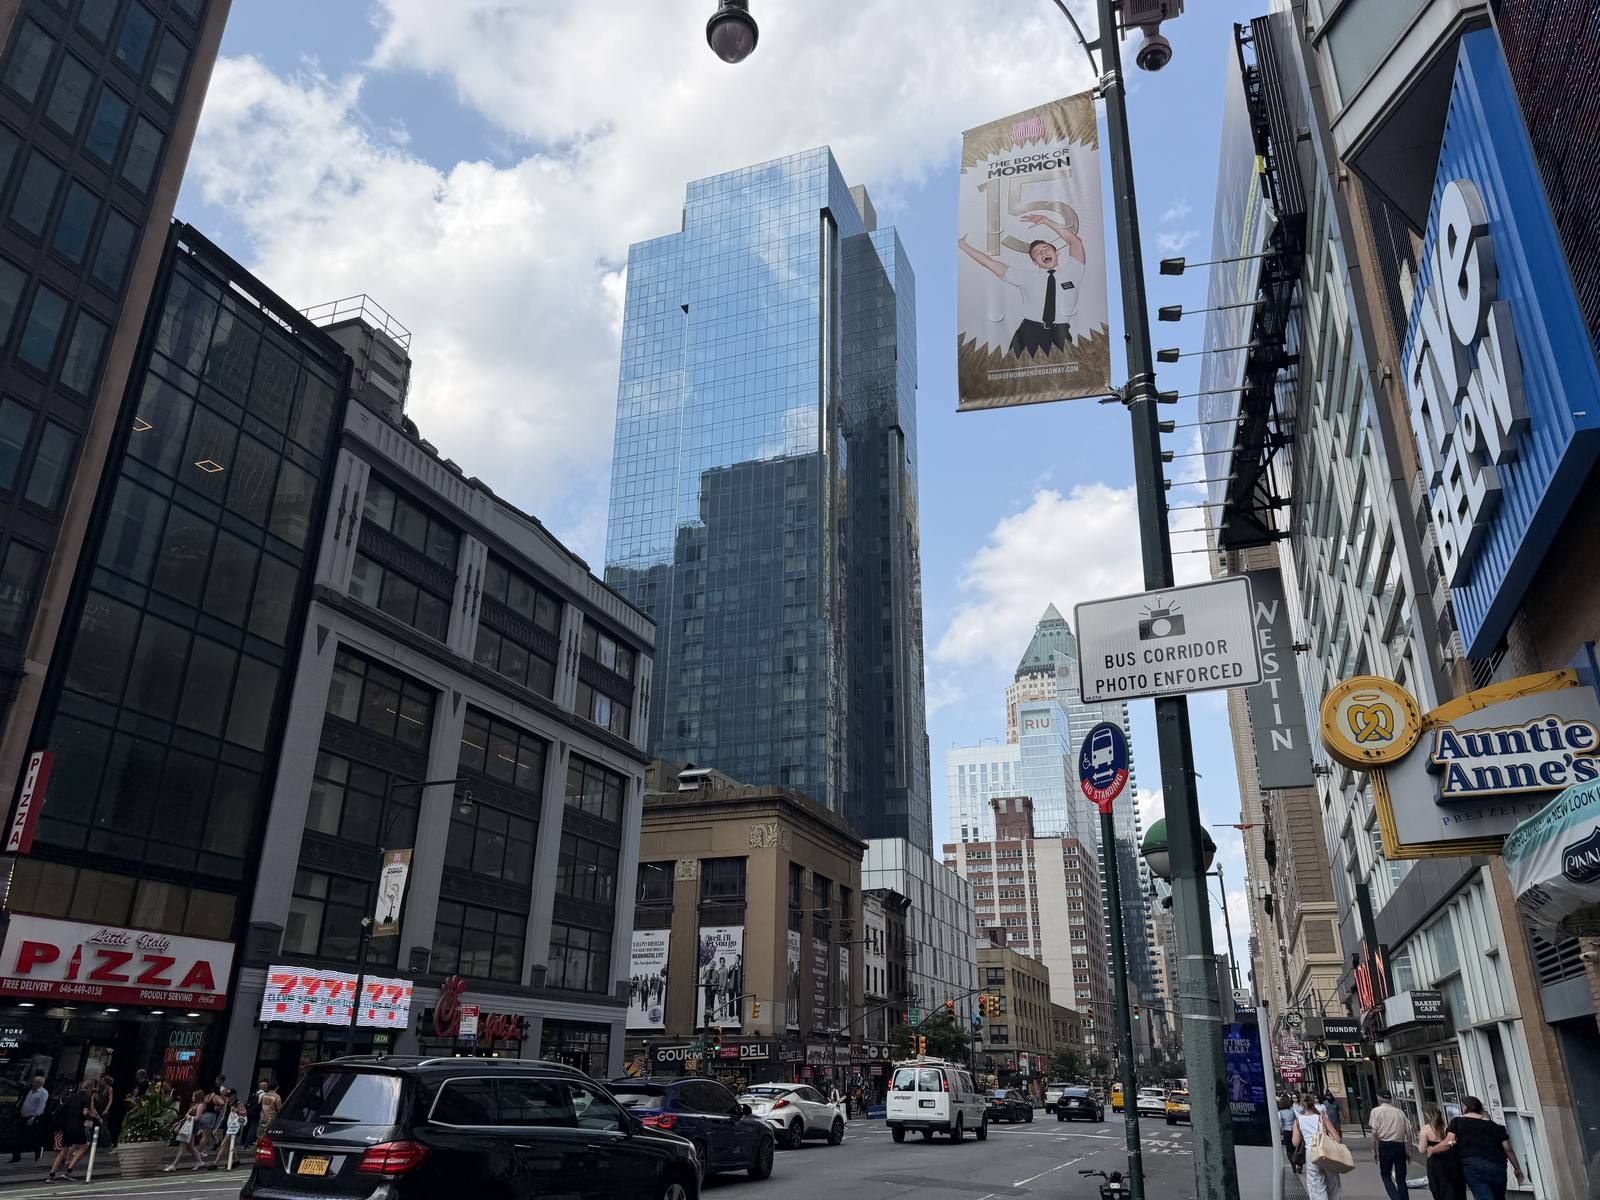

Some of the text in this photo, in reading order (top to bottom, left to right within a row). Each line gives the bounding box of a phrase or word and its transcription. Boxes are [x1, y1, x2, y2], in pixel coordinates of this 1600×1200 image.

[987, 156, 1071, 179] MORMON
[988, 149, 1070, 170] THE BOOK OF
[977, 169, 1080, 256] 15
[987, 365, 1079, 381] BOOKOFMORMONBROADWAY.COM
[1104, 639, 1229, 669] BUS CORRIDOR
[1095, 662, 1243, 694] PHOTO ENFORCED
[1255, 600, 1294, 751] WESTIN
[1025, 718, 1050, 729] RIU
[1436, 718, 1594, 761] Auntie
[1443, 753, 1599, 793] Anne's
[1083, 774, 1123, 799] NO STANDING
[10, 758, 39, 845] PIZZA
[1551, 804, 1568, 821] NEW
[1568, 789, 1597, 812] LOOK
[88, 929, 172, 953] Little Italy
[2, 979, 20, 989] FREE
[20, 981, 54, 992] DELIVERY
[140, 990, 168, 1001] PROUDLY
[168, 992, 193, 1003] SERVING
[170, 1030, 204, 1047] COLDEST
[740, 1044, 769, 1057] DELI
